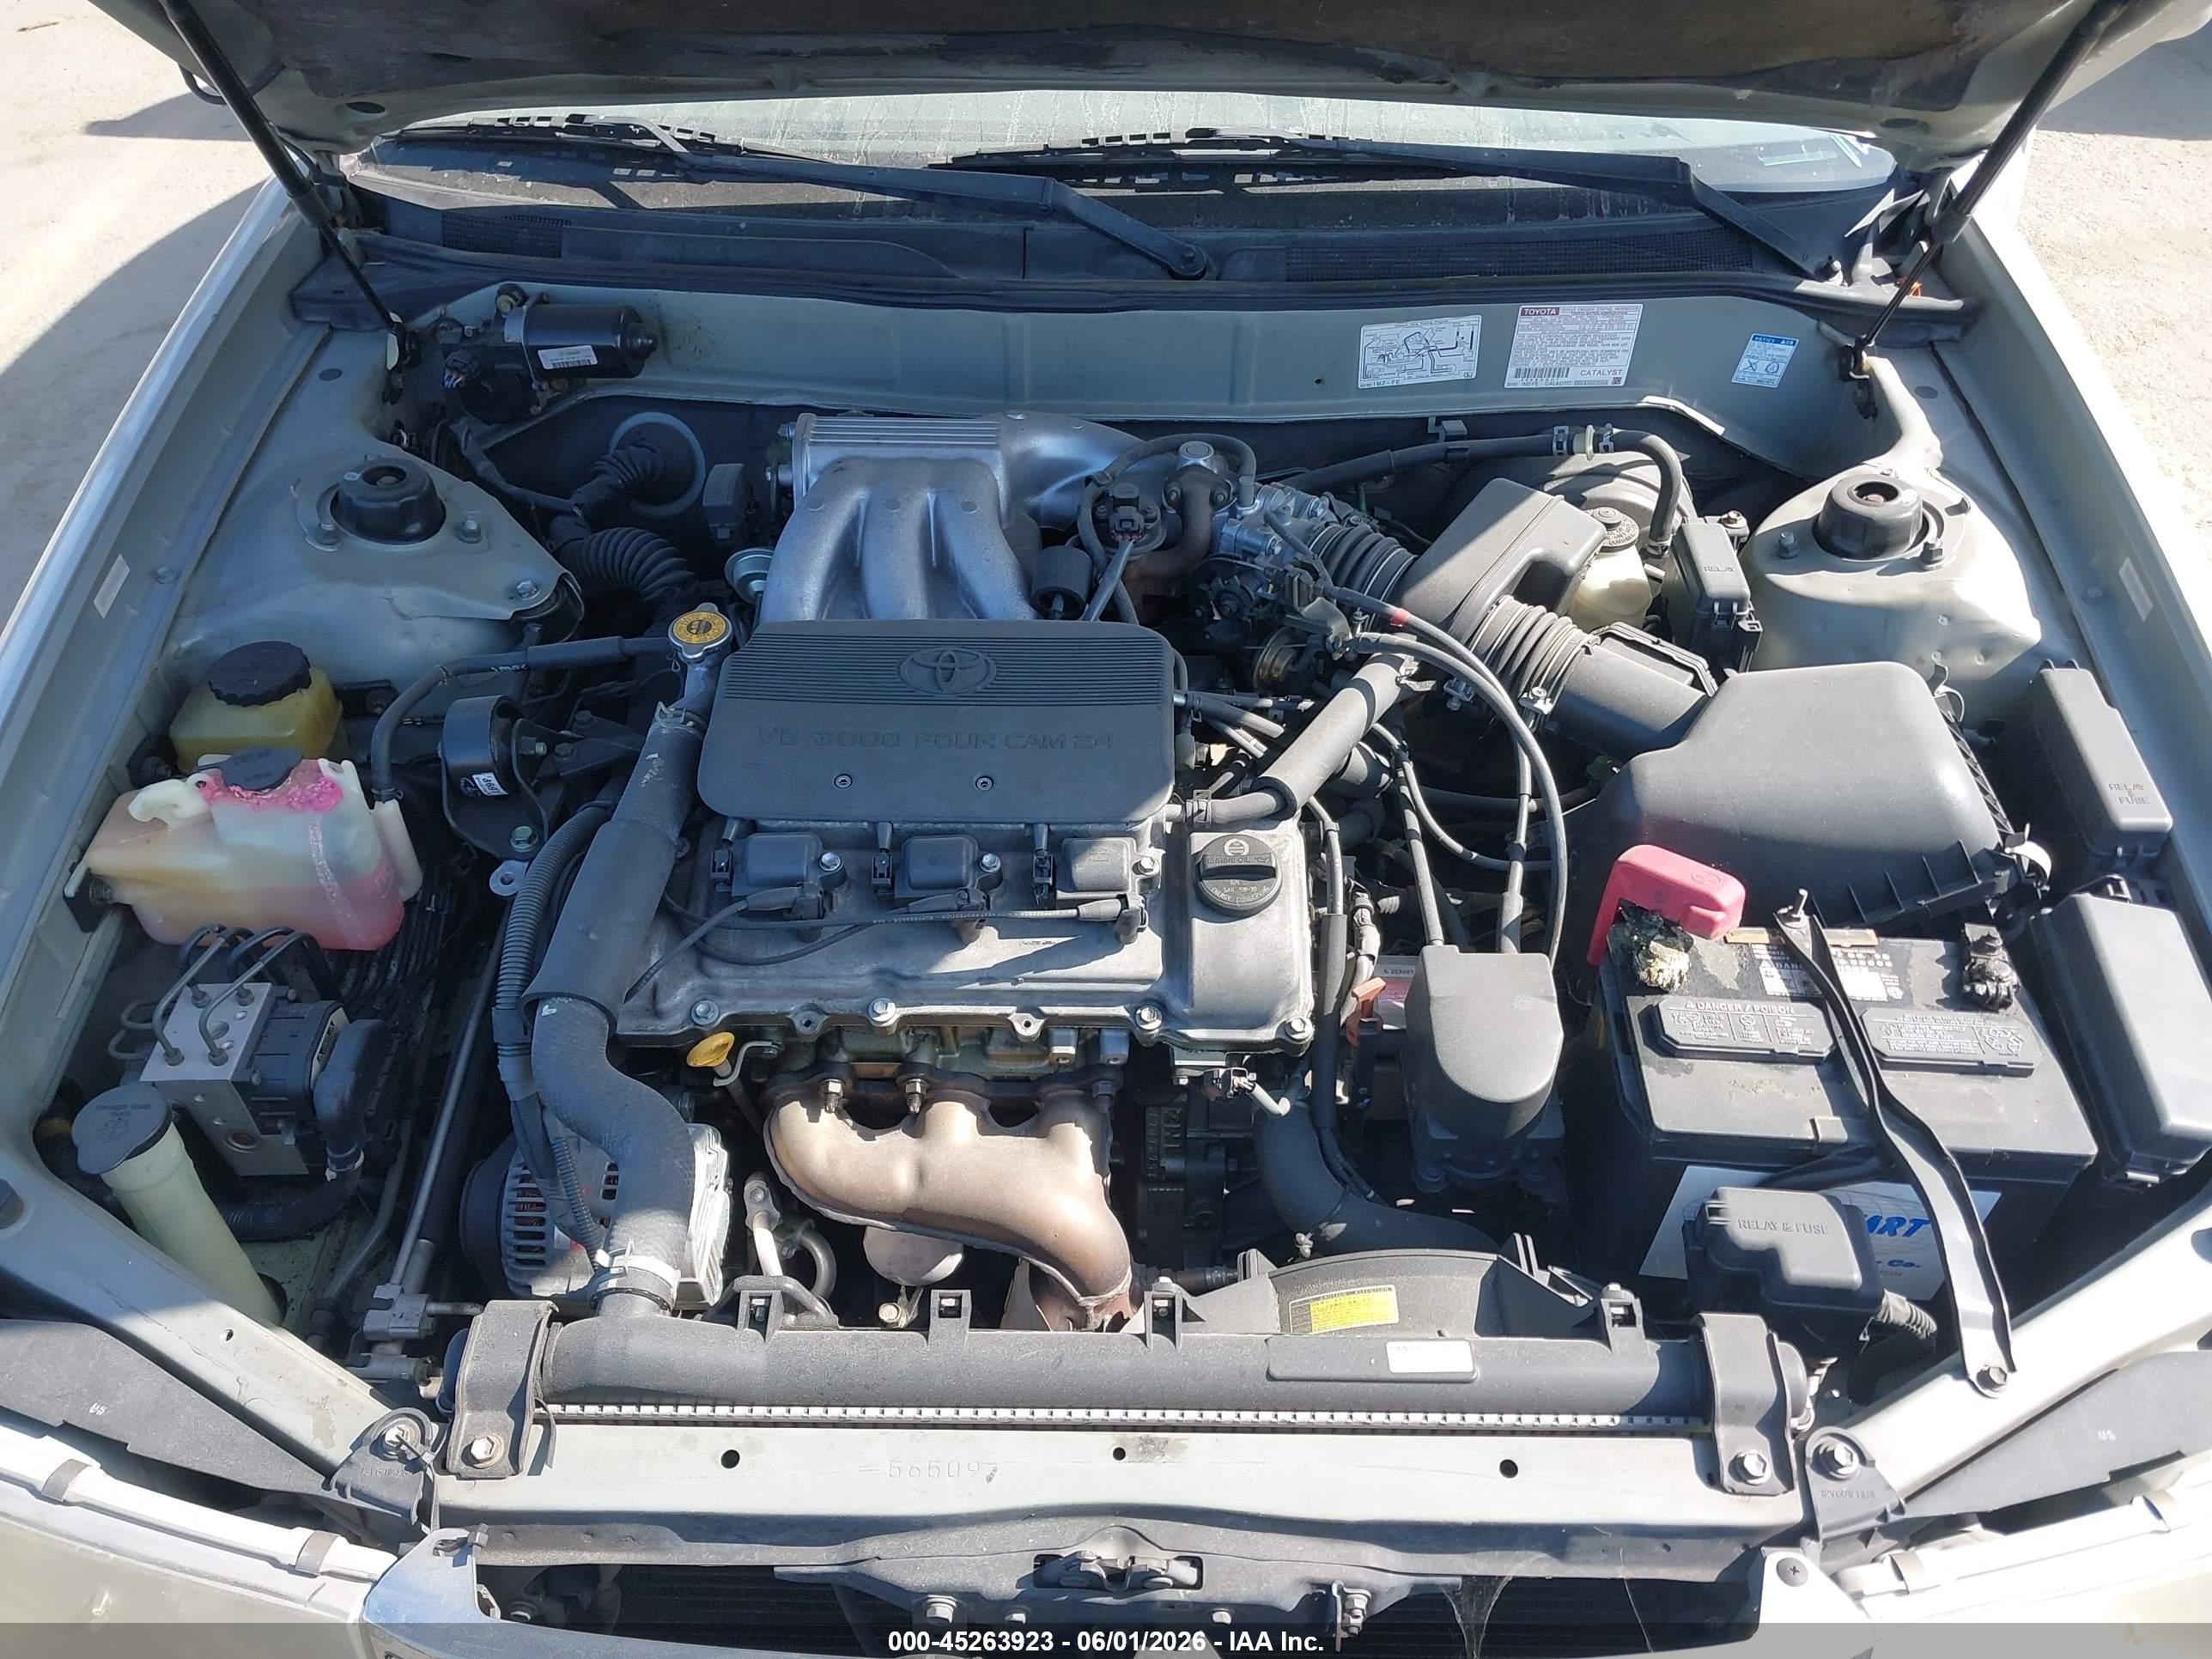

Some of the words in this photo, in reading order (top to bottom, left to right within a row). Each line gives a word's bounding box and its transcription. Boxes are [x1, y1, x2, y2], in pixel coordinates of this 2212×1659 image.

[758, 726, 801, 745] V6
[815, 730, 902, 748] 3000
[915, 732, 997, 750] FOUR
[1004, 732, 1067, 750] CAM
[1073, 732, 1115, 749] 24
[1696, 1002, 1742, 1012] DANGER
[1753, 1004, 1796, 1014] POISON
[1738, 1219, 1778, 1232] RELAY
[1782, 1222, 1793, 1232] &
[1795, 1223, 1828, 1236] FUSE
